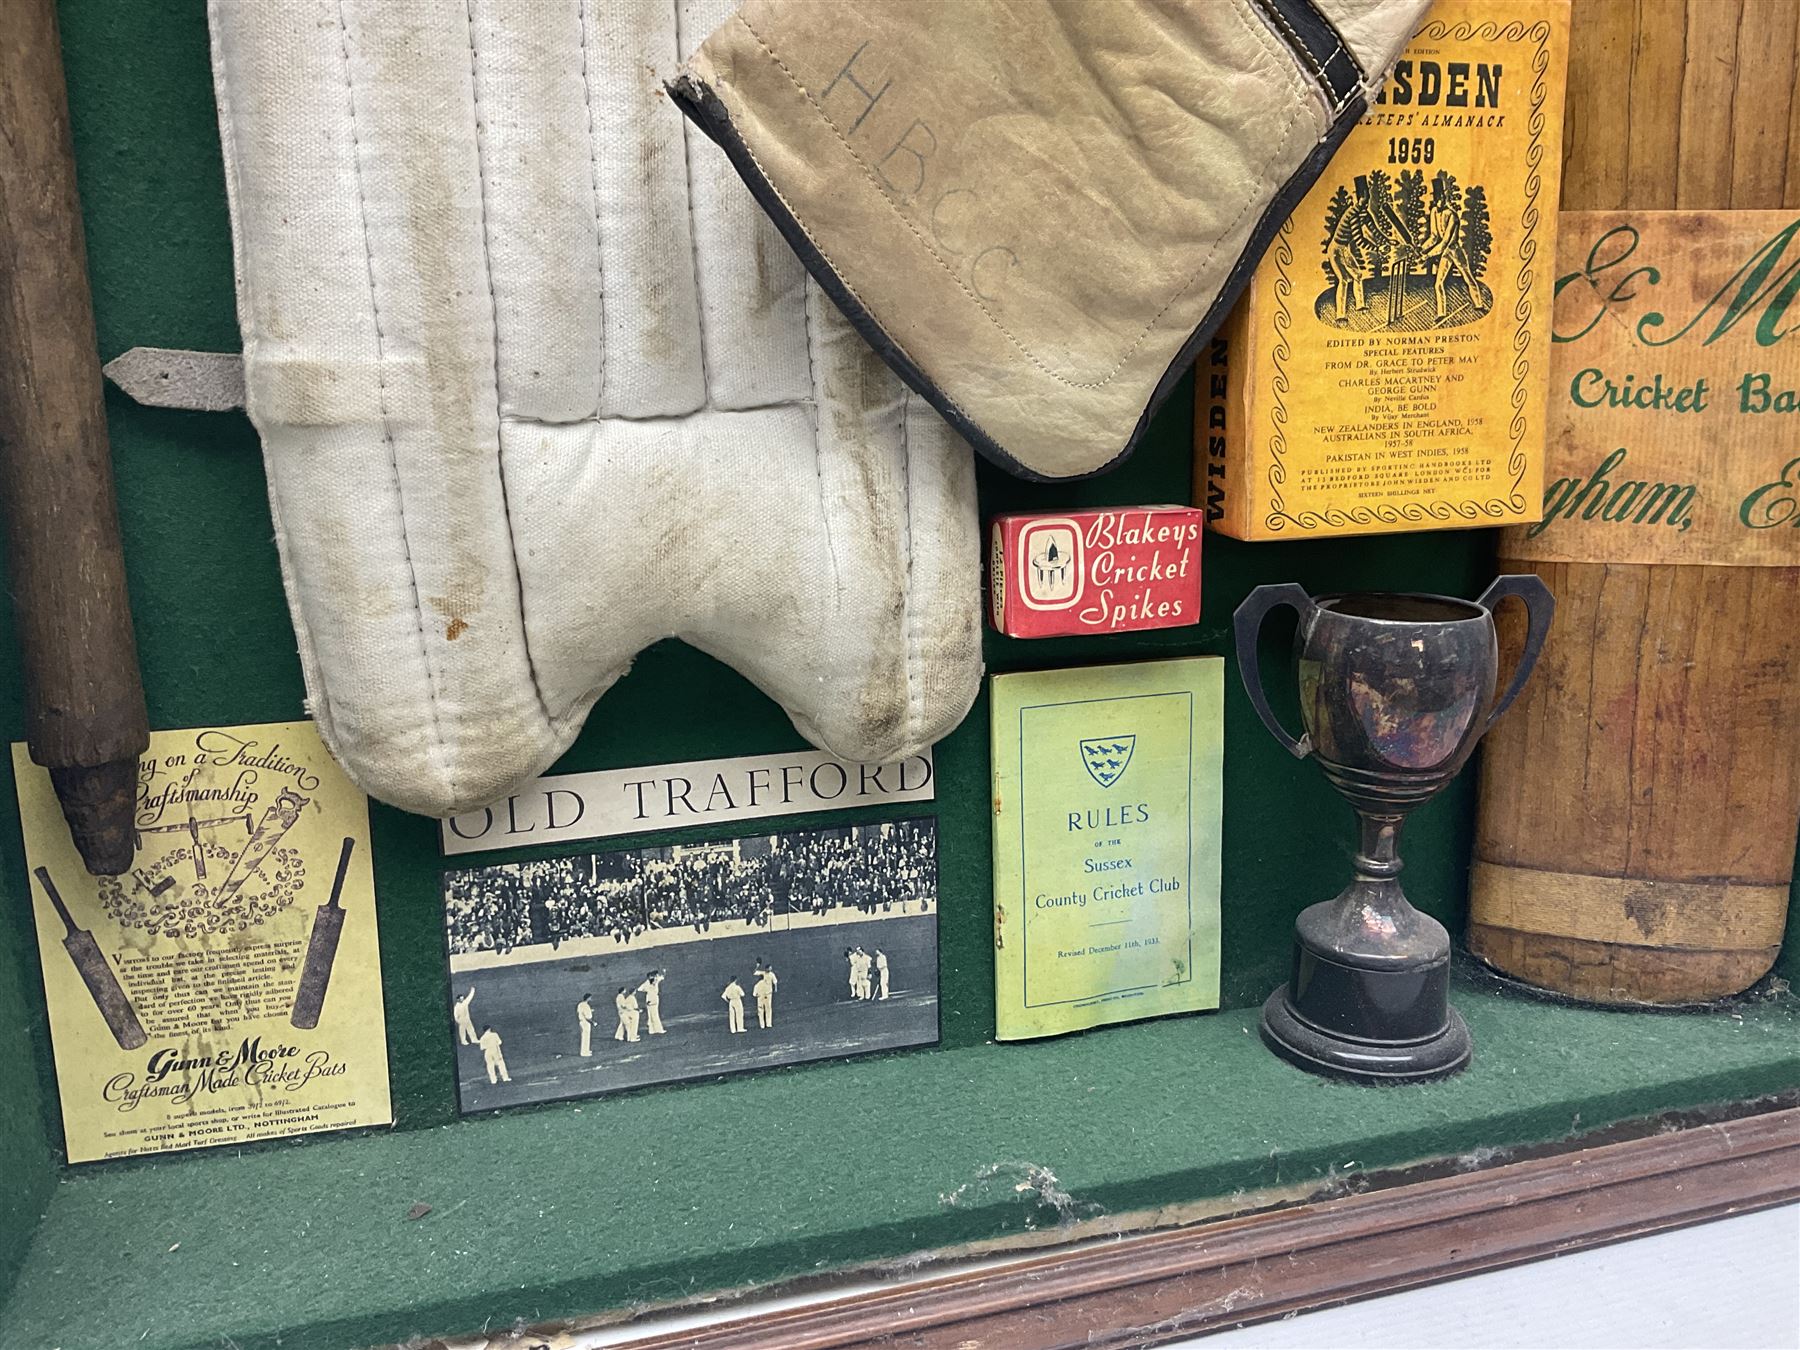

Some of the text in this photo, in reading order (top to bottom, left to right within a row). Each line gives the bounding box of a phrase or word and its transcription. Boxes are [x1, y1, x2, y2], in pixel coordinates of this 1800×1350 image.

[1422, 114, 1506, 127] ALMANACK
[1388, 137, 1435, 164] 1959
[1326, 334, 1480, 348] EDITED BY NORMAN PRESTON
[1363, 346, 1444, 357] SPECIAL FEATURES
[1325, 361, 1352, 370] FROM
[1356, 360, 1372, 368] DR.
[1376, 359, 1408, 367] GRACE
[1428, 357, 1454, 365] PETER
[1459, 355, 1479, 363] MAY
[1339, 378, 1380, 387] CHARLES
[1385, 375, 1441, 385] MACARTNEY
[1368, 385, 1437, 395] GEORGE GUNN
[1570, 368, 1710, 413] Cricket
[1365, 402, 1437, 414] INDIA, BE BOLD
[1206, 337, 1228, 524] WISDEN
[1314, 426, 1335, 434] NEW
[1339, 423, 1399, 432] ZEALANDERS
[1417, 419, 1462, 428] ENGLAND,
[1468, 418, 1483, 426] 1958
[1323, 432, 1386, 442] AUSTRALIANS
[1404, 429, 1434, 438] SOUTH
[1438, 427, 1473, 436] AFRICA,
[1385, 440, 1413, 448] 1957-58
[1326, 452, 1370, 462] PAKISTAN
[1375, 452, 1385, 460] IN
[1417, 448, 1448, 457] INDIES,
[1321, 481, 1380, 490] PROPRIETORS
[1086, 512, 1198, 549] Blakeys
[1092, 548, 1190, 586] Cricket
[1080, 589, 1183, 628] Spikes
[165, 731, 319, 790] on a Tradition
[182, 768, 200, 788] of
[450, 755, 932, 839] OLD TRAFFORD
[1068, 803, 1150, 832] RULES
[1084, 858, 1132, 873] Sussex
[1036, 876, 1180, 909] County Cricket Club
[1058, 948, 1085, 958] Revised
[1089, 944, 1121, 954] December
[1124, 940, 1141, 948] 11th,
[169, 998, 205, 1007] perfection
[146, 1036, 300, 1083] Gunn & Moore
[102, 1050, 347, 1112] Craftsman Made Cricket Bats
[275, 1106, 310, 1116] Illustrated
[312, 1102, 346, 1111] Catalogue
[144, 1134, 174, 1142] GUNN
[189, 1126, 224, 1137] MOORE
[254, 1114, 319, 1128] NOTTINGHAM
